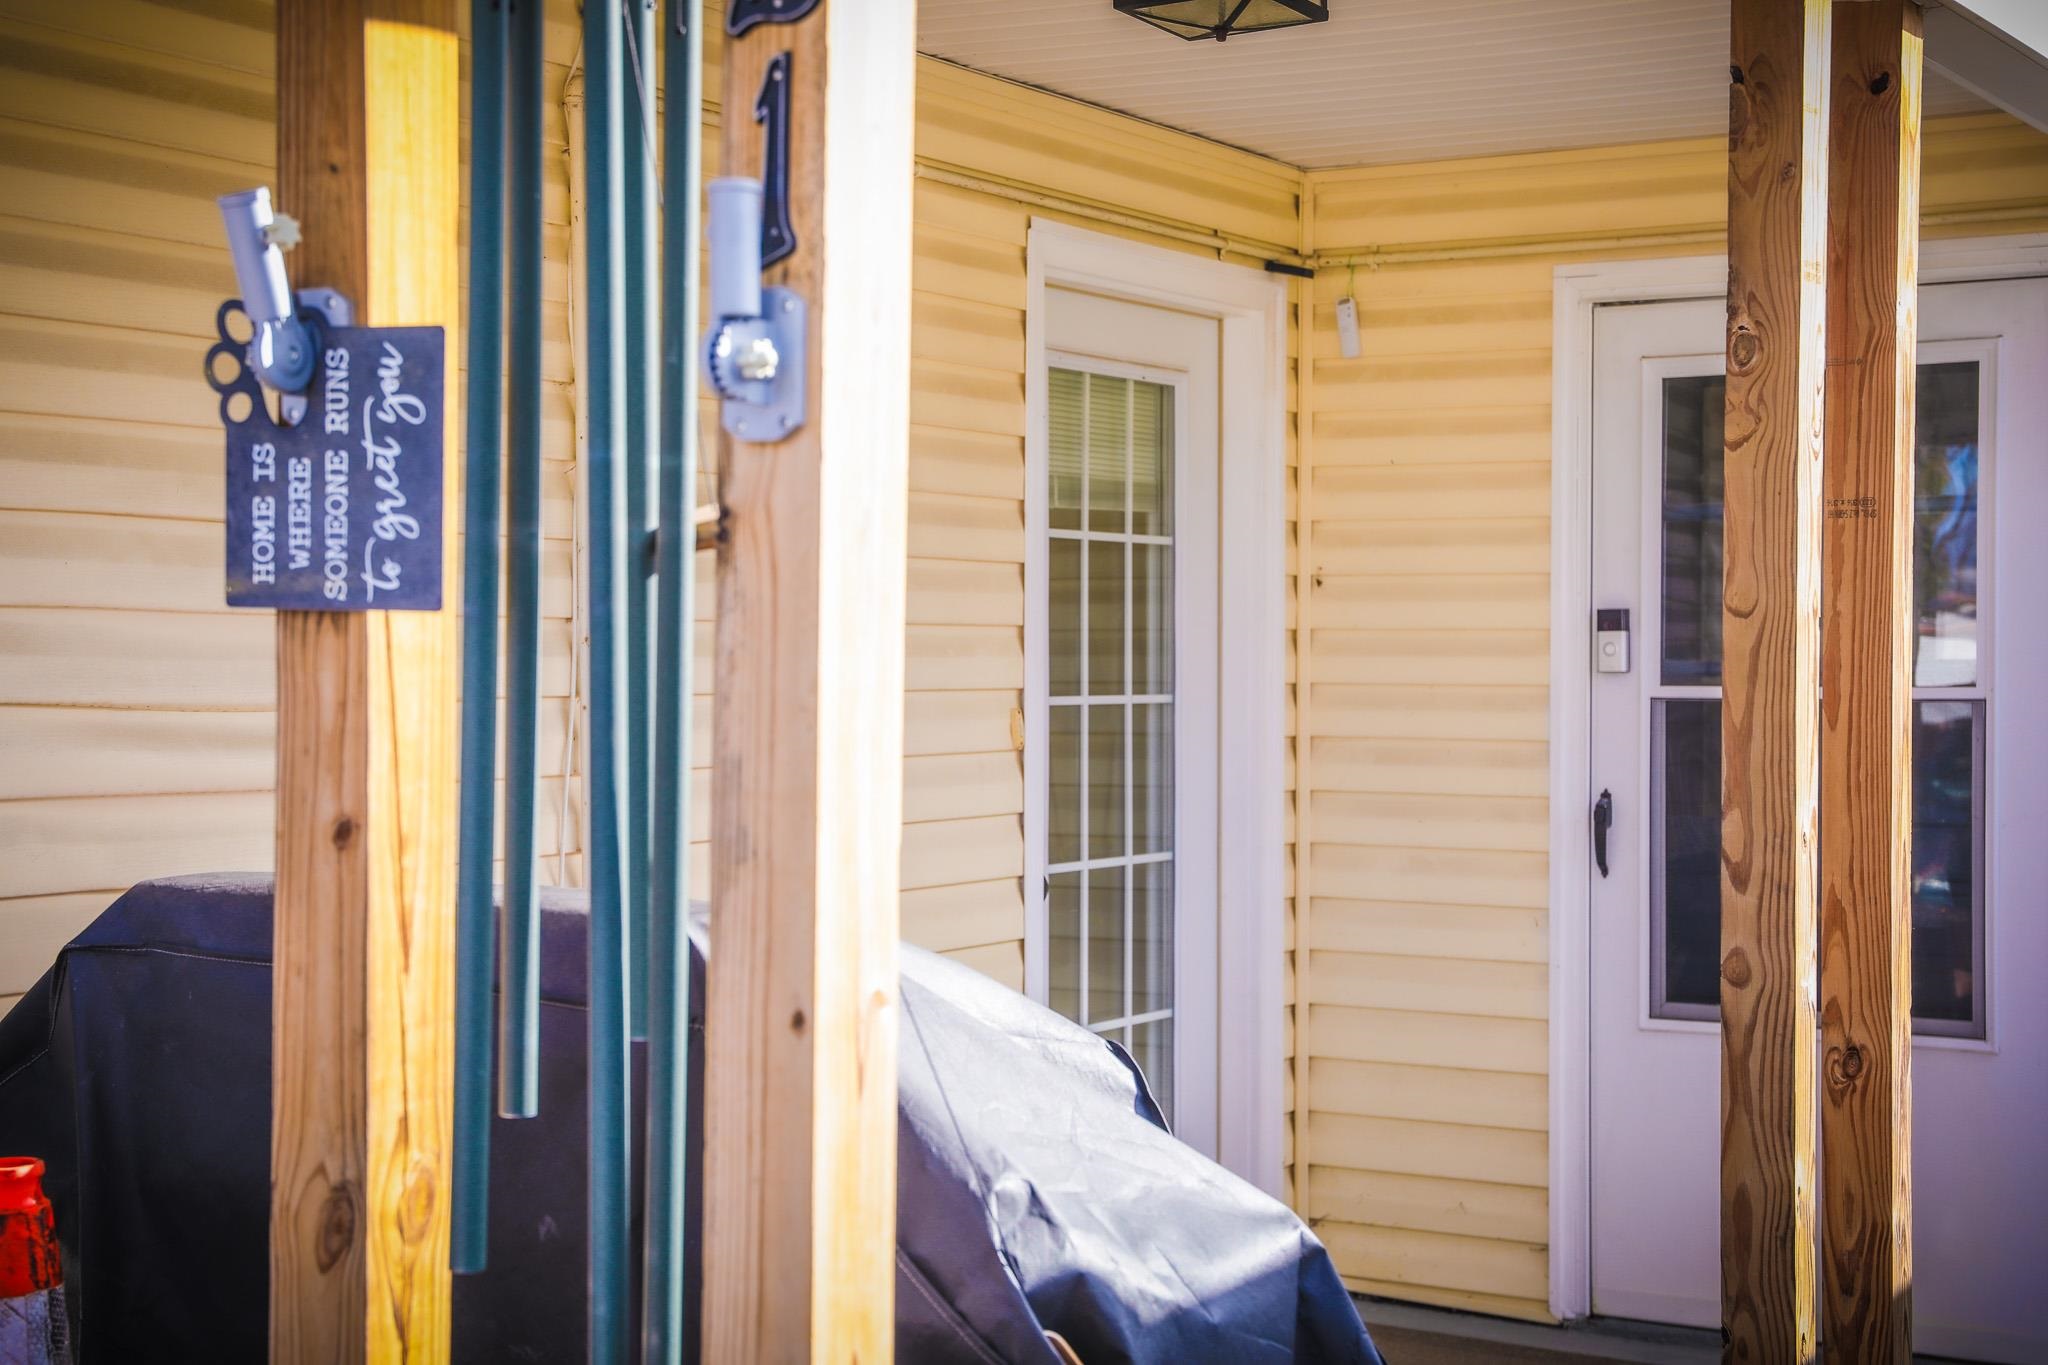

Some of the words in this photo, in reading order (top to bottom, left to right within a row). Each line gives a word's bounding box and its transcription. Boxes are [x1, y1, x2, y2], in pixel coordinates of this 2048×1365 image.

[755, 51, 796, 272] 1
[325, 347, 349, 435] RUNS
[376, 340, 426, 425] you
[252, 442, 276, 482] IS
[361, 395, 420, 540] greet
[252, 496, 276, 584] HOME
[288, 457, 311, 569] WHERE
[324, 450, 349, 601] SOMEONE
[361, 537, 402, 603] to
